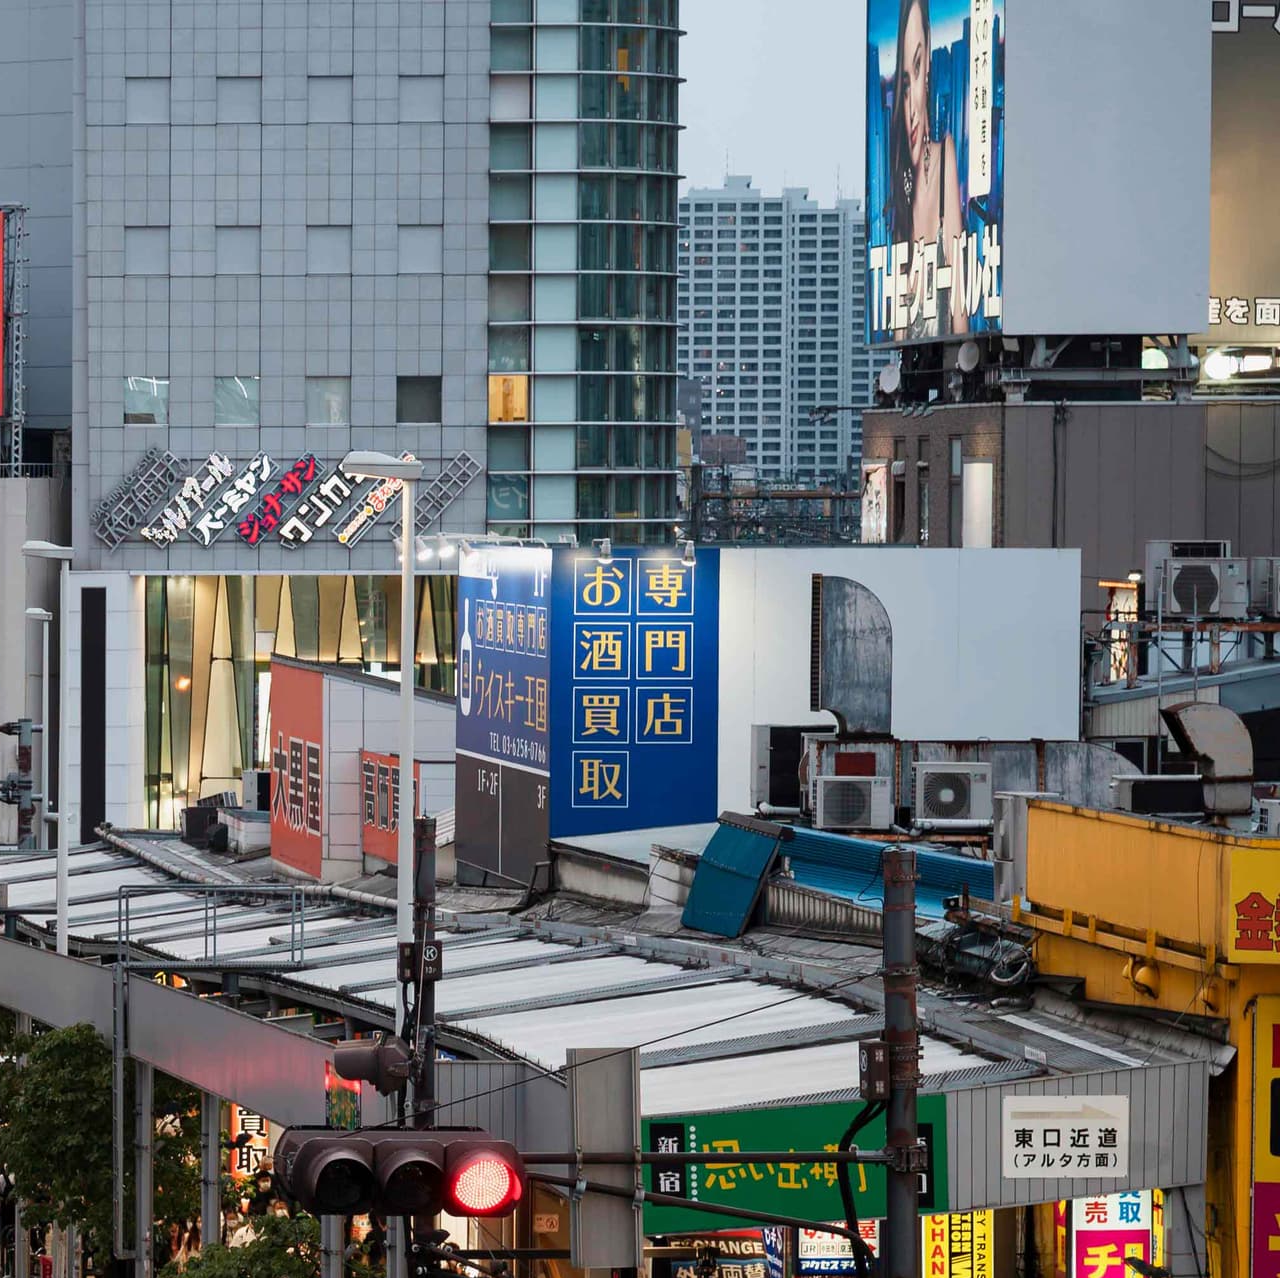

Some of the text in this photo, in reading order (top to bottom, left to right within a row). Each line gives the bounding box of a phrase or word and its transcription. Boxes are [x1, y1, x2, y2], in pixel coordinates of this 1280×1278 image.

[870, 223, 1002, 332] THEグローバル社
[238, 456, 316, 545] ジョナサン
[475, 604, 547, 653] お酒買取専門店
[475, 659, 547, 732] ウイスキー王国
[579, 563, 687, 801] お酒買取 専門店
[489, 732, 501, 753] TEL
[272, 730, 321, 838] 大黒屋
[362, 757, 416, 835] 高価買
[536, 785, 546, 810] 3F
[1235, 892, 1280, 951] 金
[1012, 1152, 1120, 1170] (アルタ方面)
[1013, 1127, 1119, 1149] 東口近道
[800, 1259, 859, 1271] アクセスチケ
